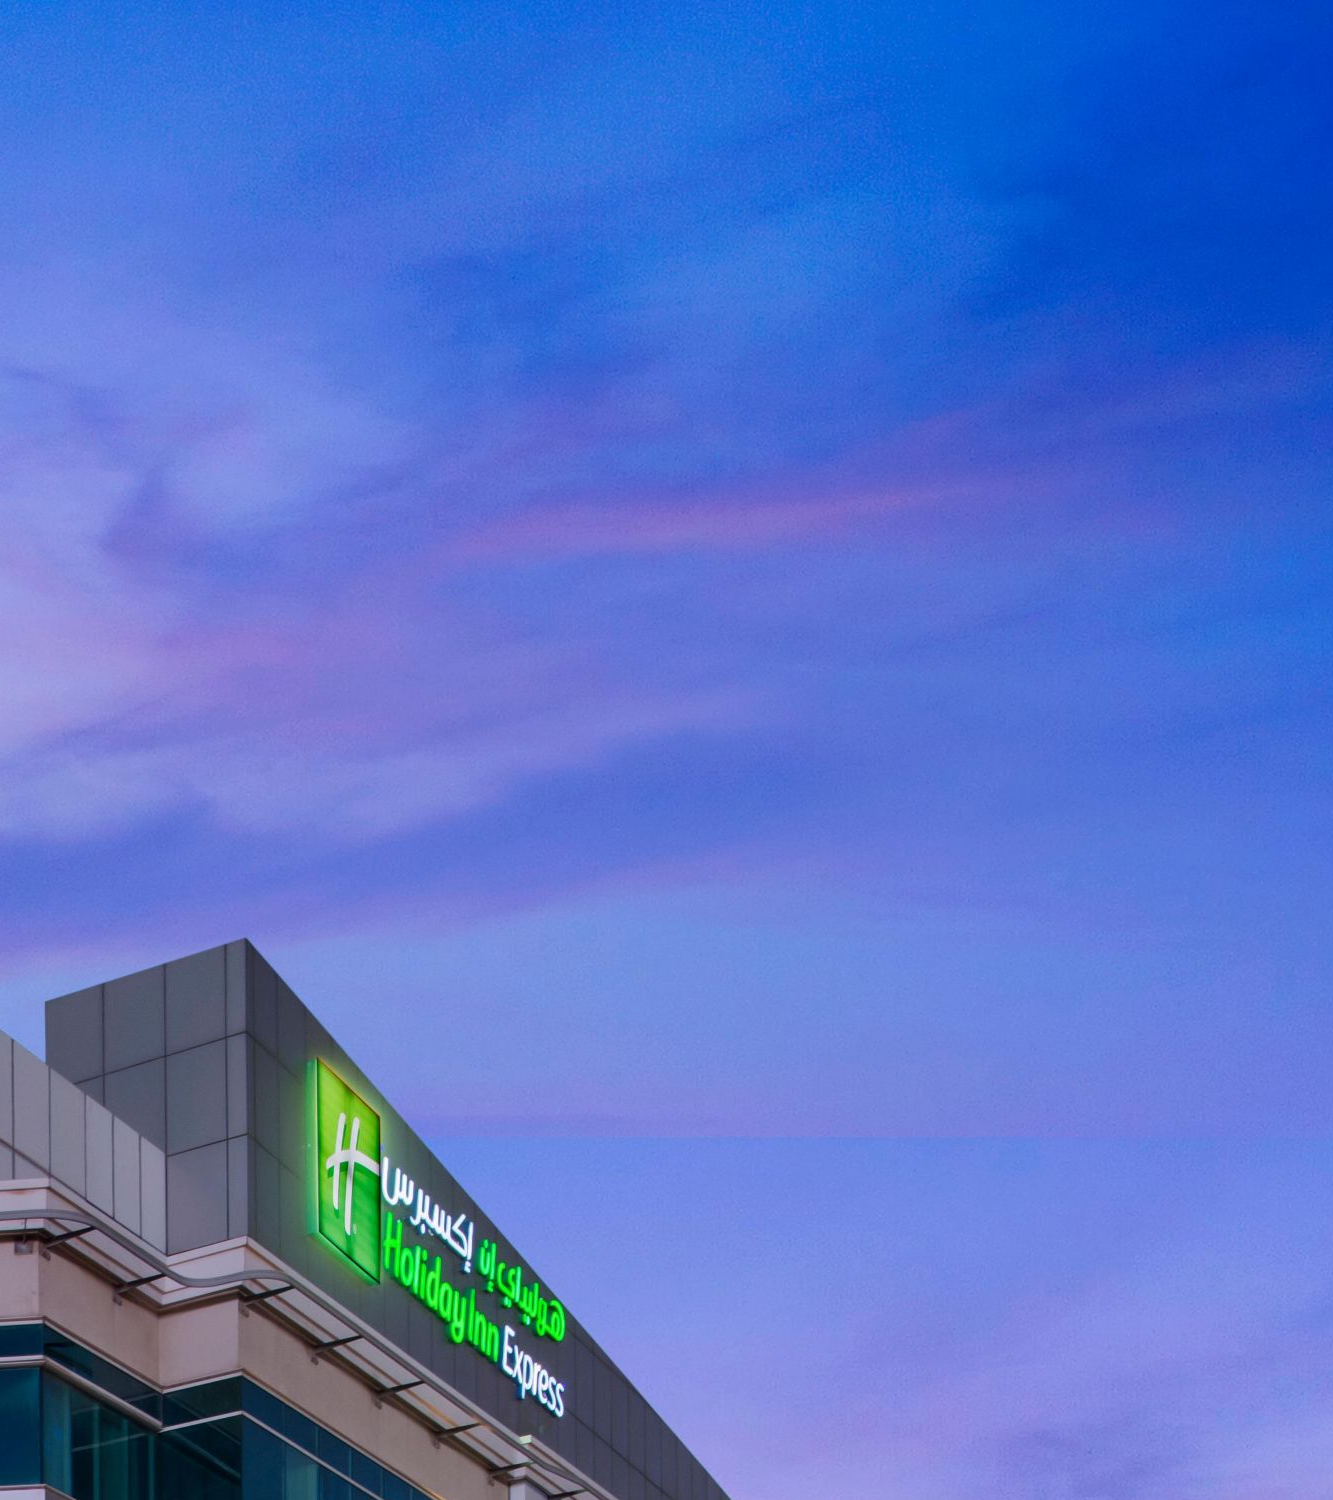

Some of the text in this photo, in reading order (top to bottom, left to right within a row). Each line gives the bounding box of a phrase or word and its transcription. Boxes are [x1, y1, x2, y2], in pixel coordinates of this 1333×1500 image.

[383, 1211, 565, 1418] Holiday Inn Express
